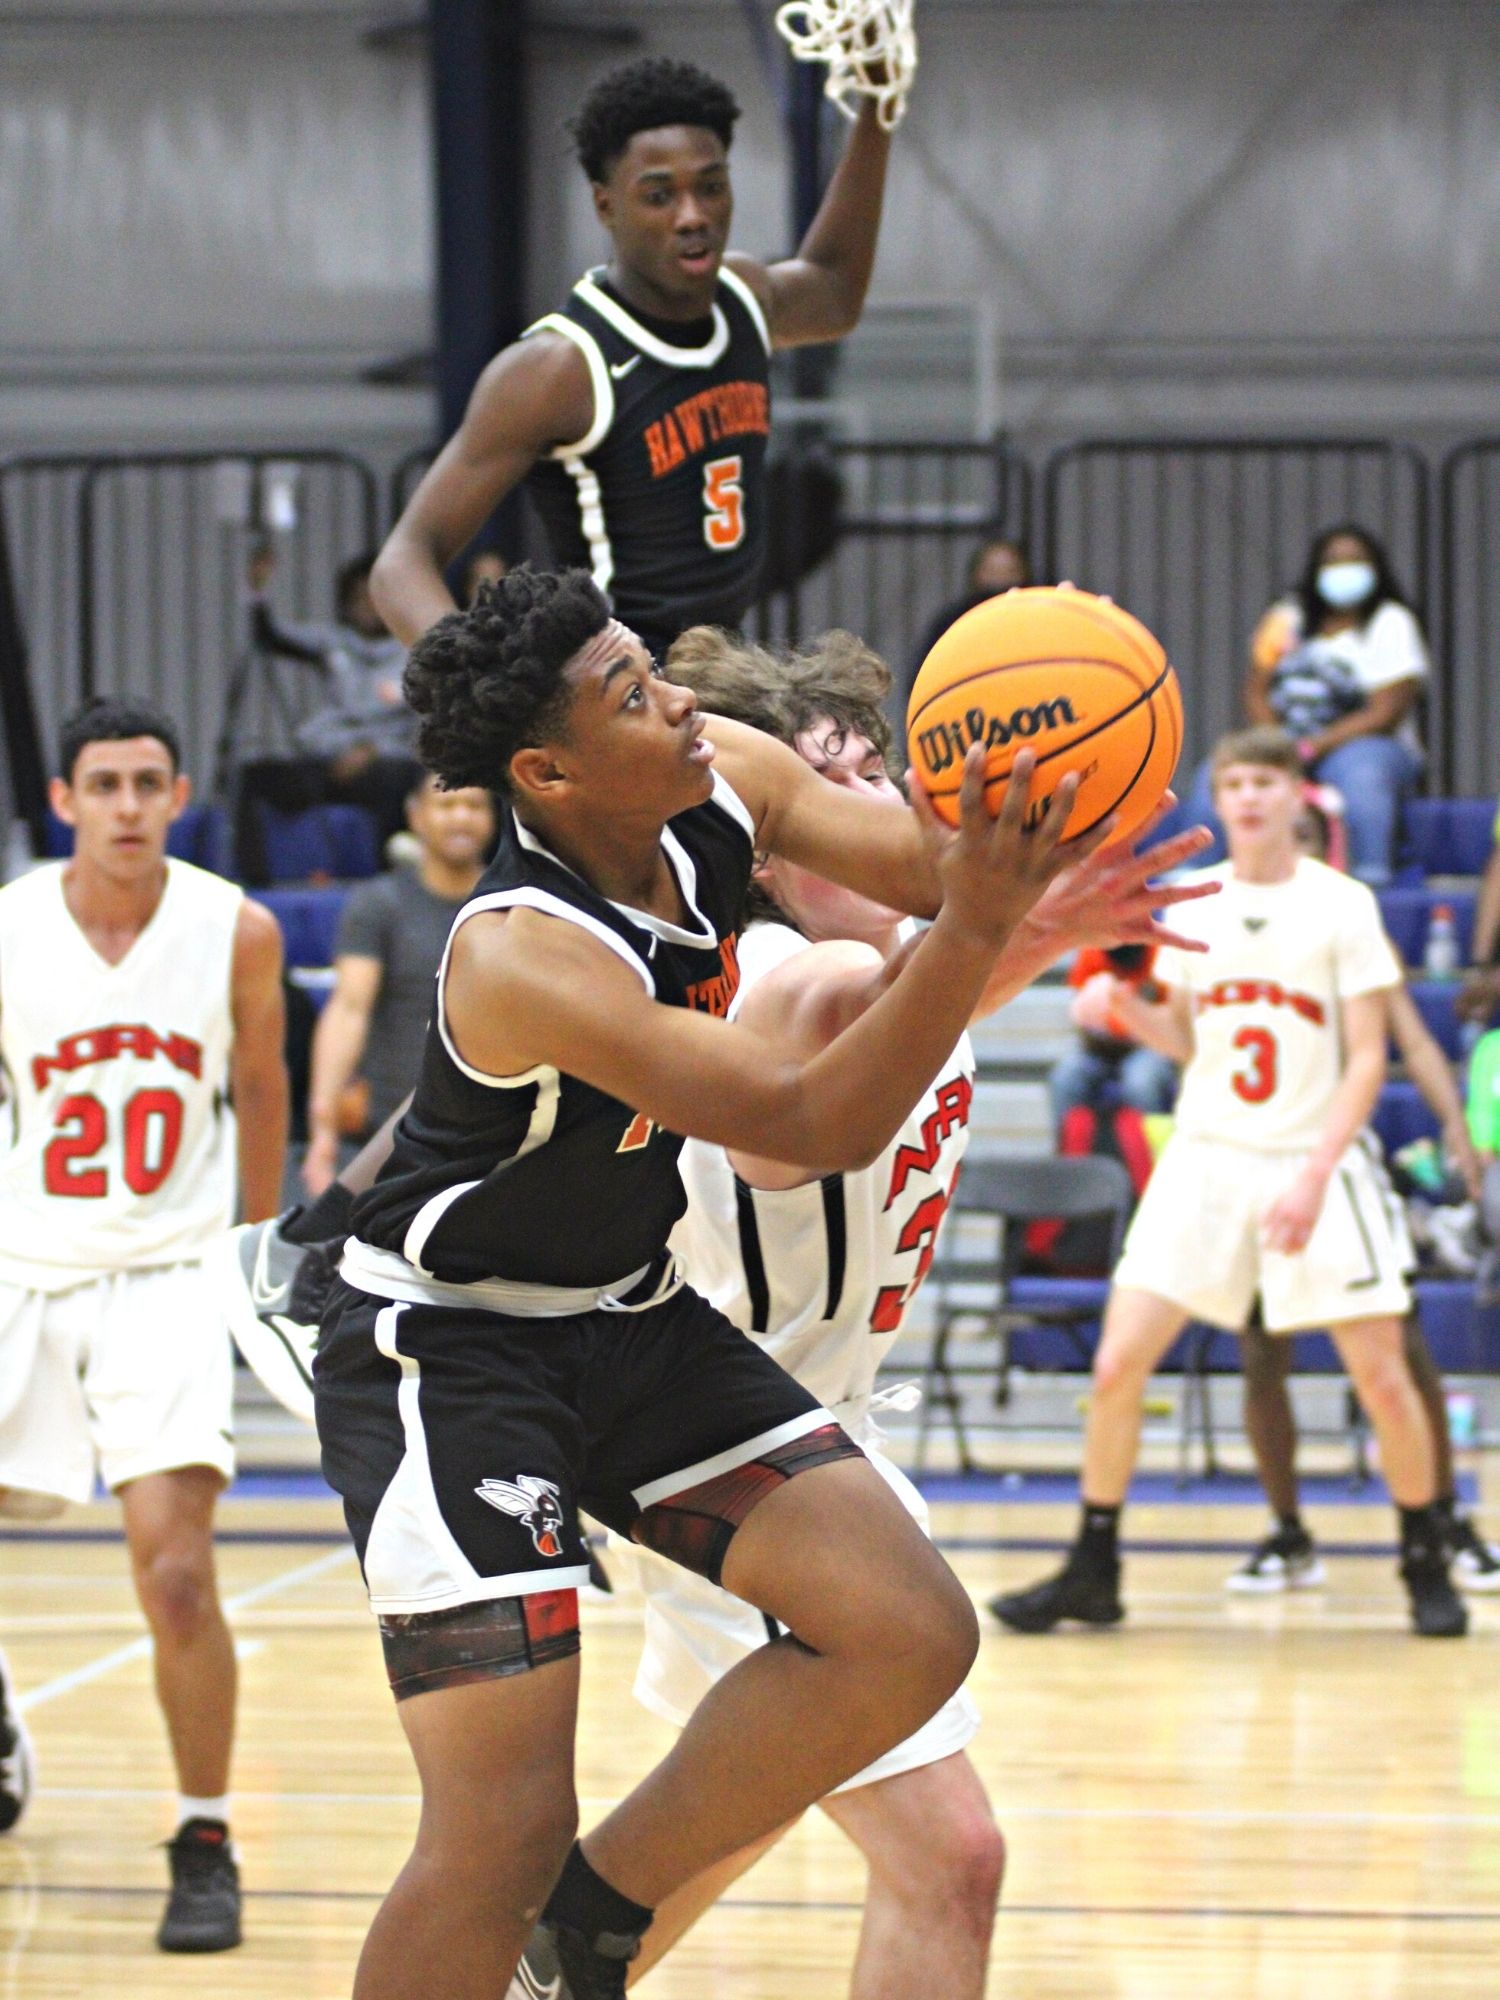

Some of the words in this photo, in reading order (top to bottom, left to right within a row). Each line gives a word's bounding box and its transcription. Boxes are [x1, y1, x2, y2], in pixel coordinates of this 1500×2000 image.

[703, 455, 745, 552] 5
[918, 696, 1076, 774] Wilson
[1232, 1024, 1278, 1105] 3
[43, 1086, 184, 1198] 20
